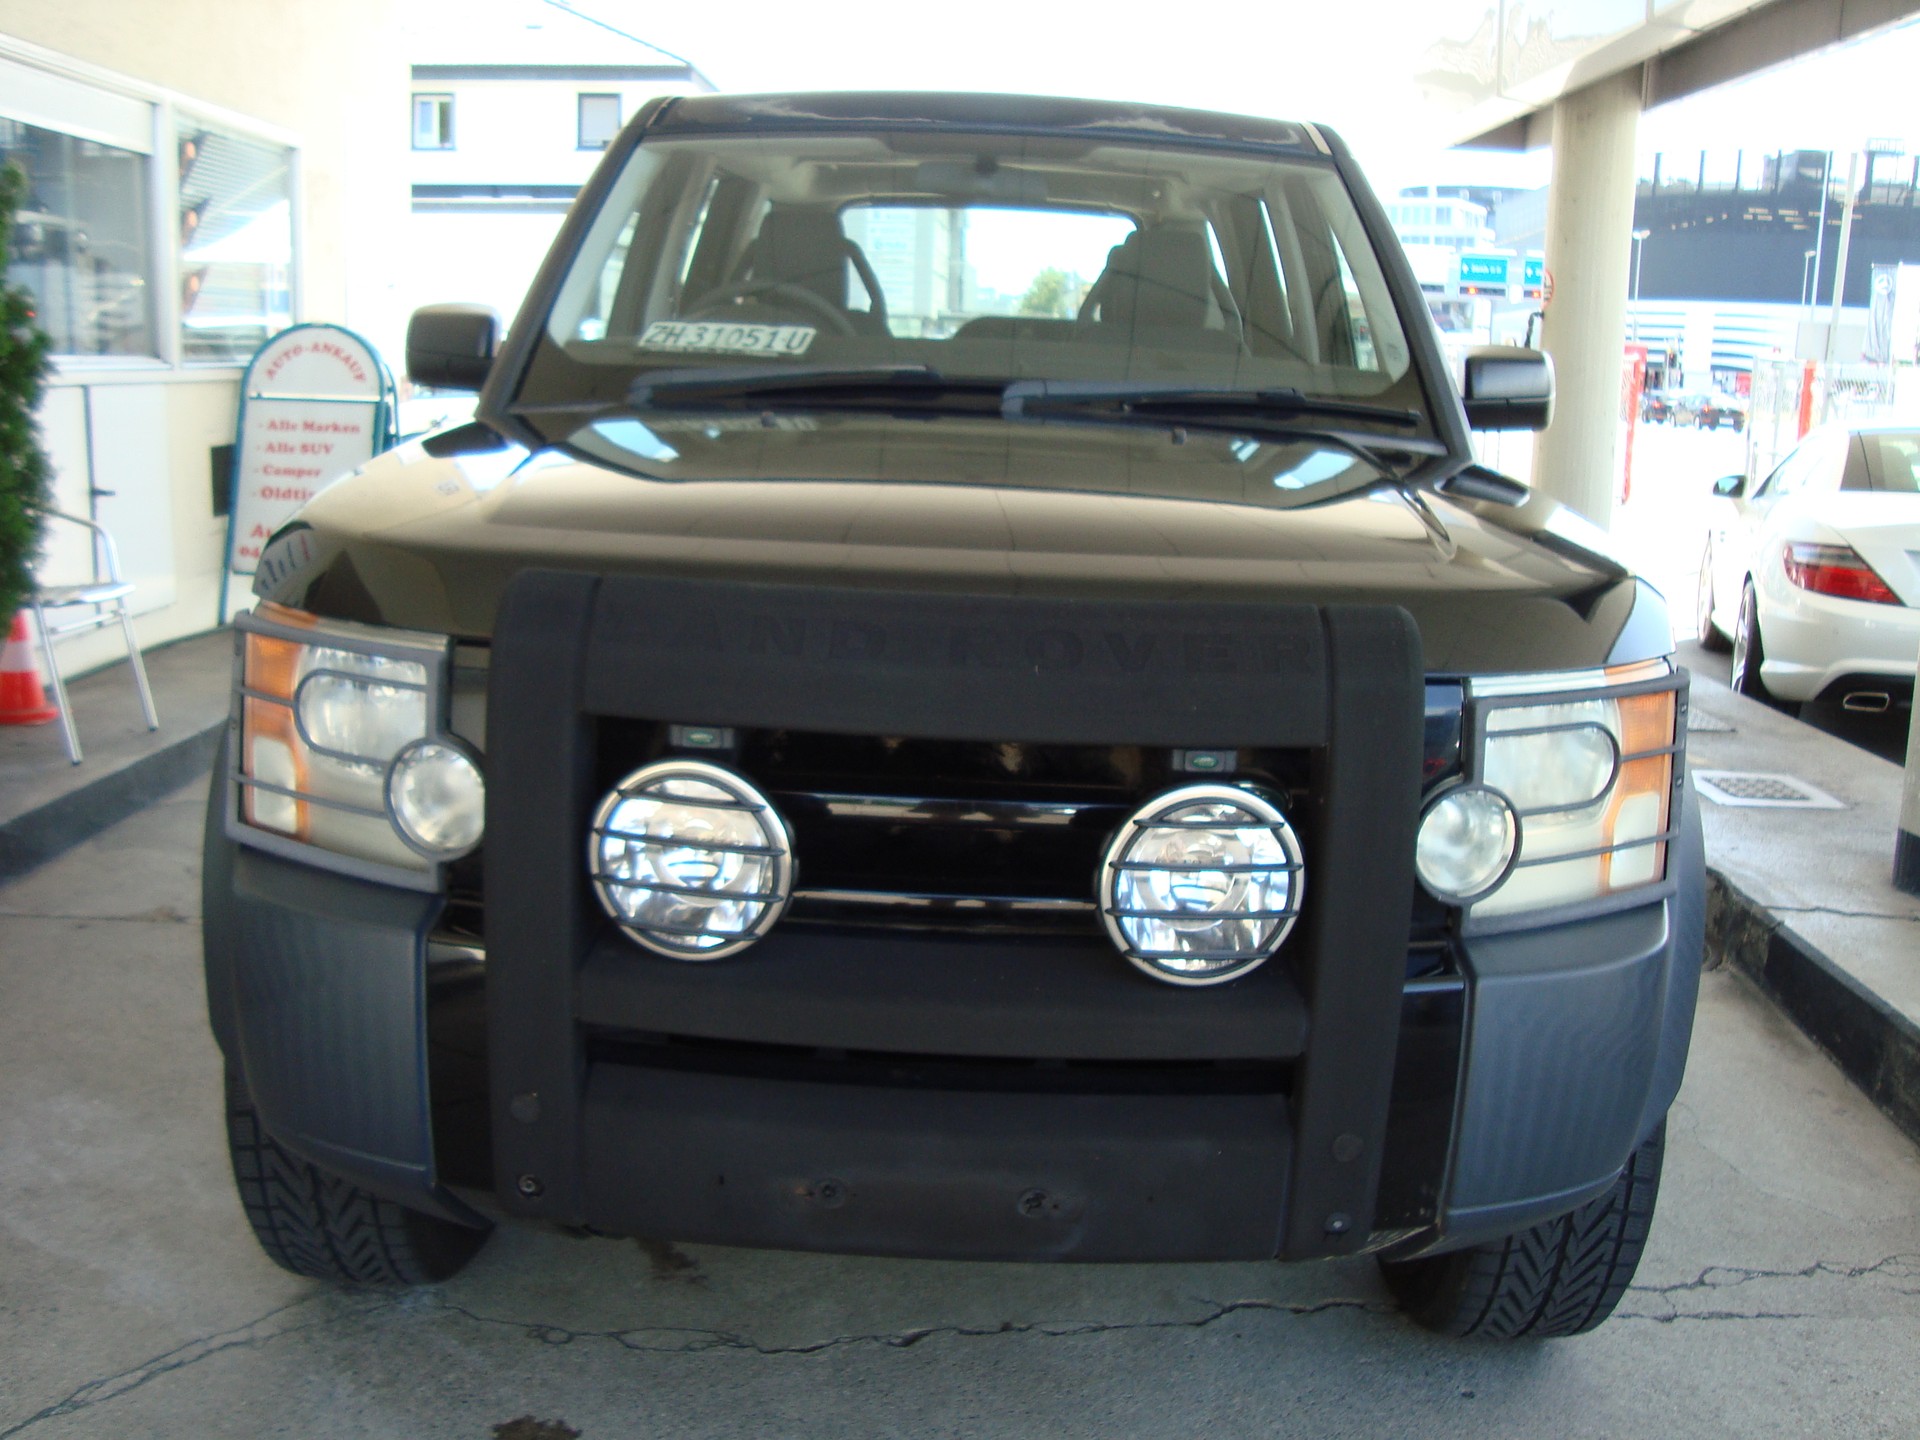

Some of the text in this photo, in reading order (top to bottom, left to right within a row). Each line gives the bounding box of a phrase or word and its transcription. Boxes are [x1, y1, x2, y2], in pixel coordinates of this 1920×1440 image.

[267, 419, 361, 434] Alle Marken
[265, 441, 334, 456] Alle SUV
[262, 463, 322, 479] Camper
[946, 626, 1317, 675] ROVER
